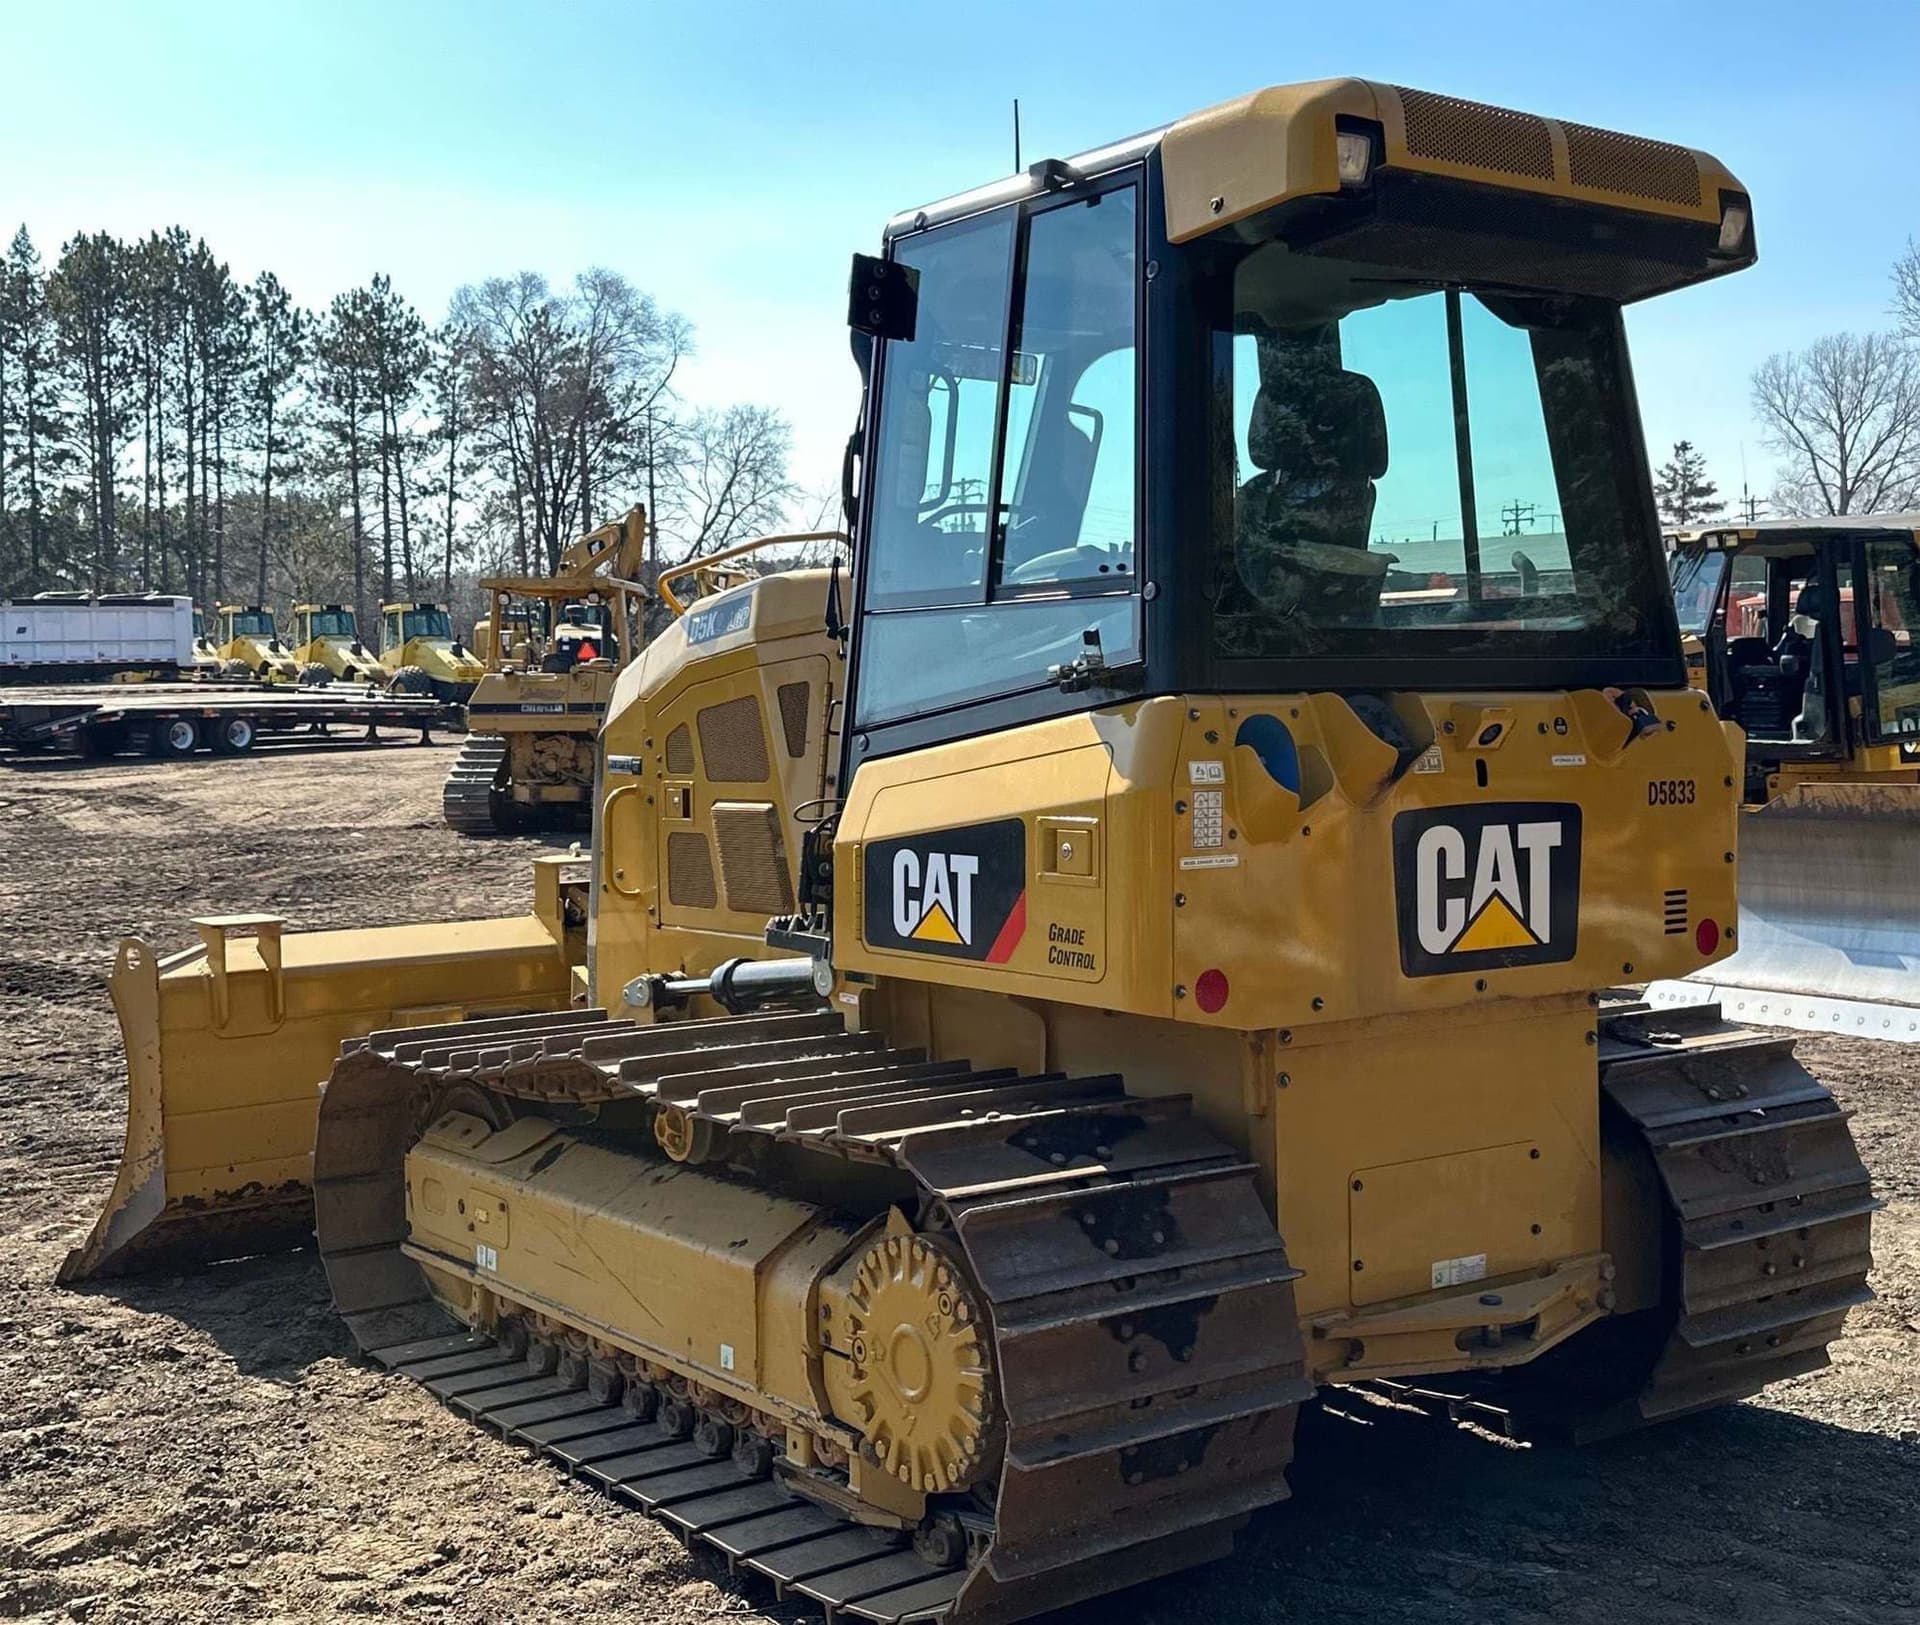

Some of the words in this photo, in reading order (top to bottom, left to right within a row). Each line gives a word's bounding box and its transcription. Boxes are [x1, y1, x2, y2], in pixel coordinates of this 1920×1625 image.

[688, 611, 718, 643] D5K
[1648, 780, 1696, 806] D5833
[892, 848, 979, 946] CAT
[1416, 821, 1562, 954] CAT
[1048, 922, 1086, 946] GRADE
[1048, 945, 1096, 970] CONTROL
